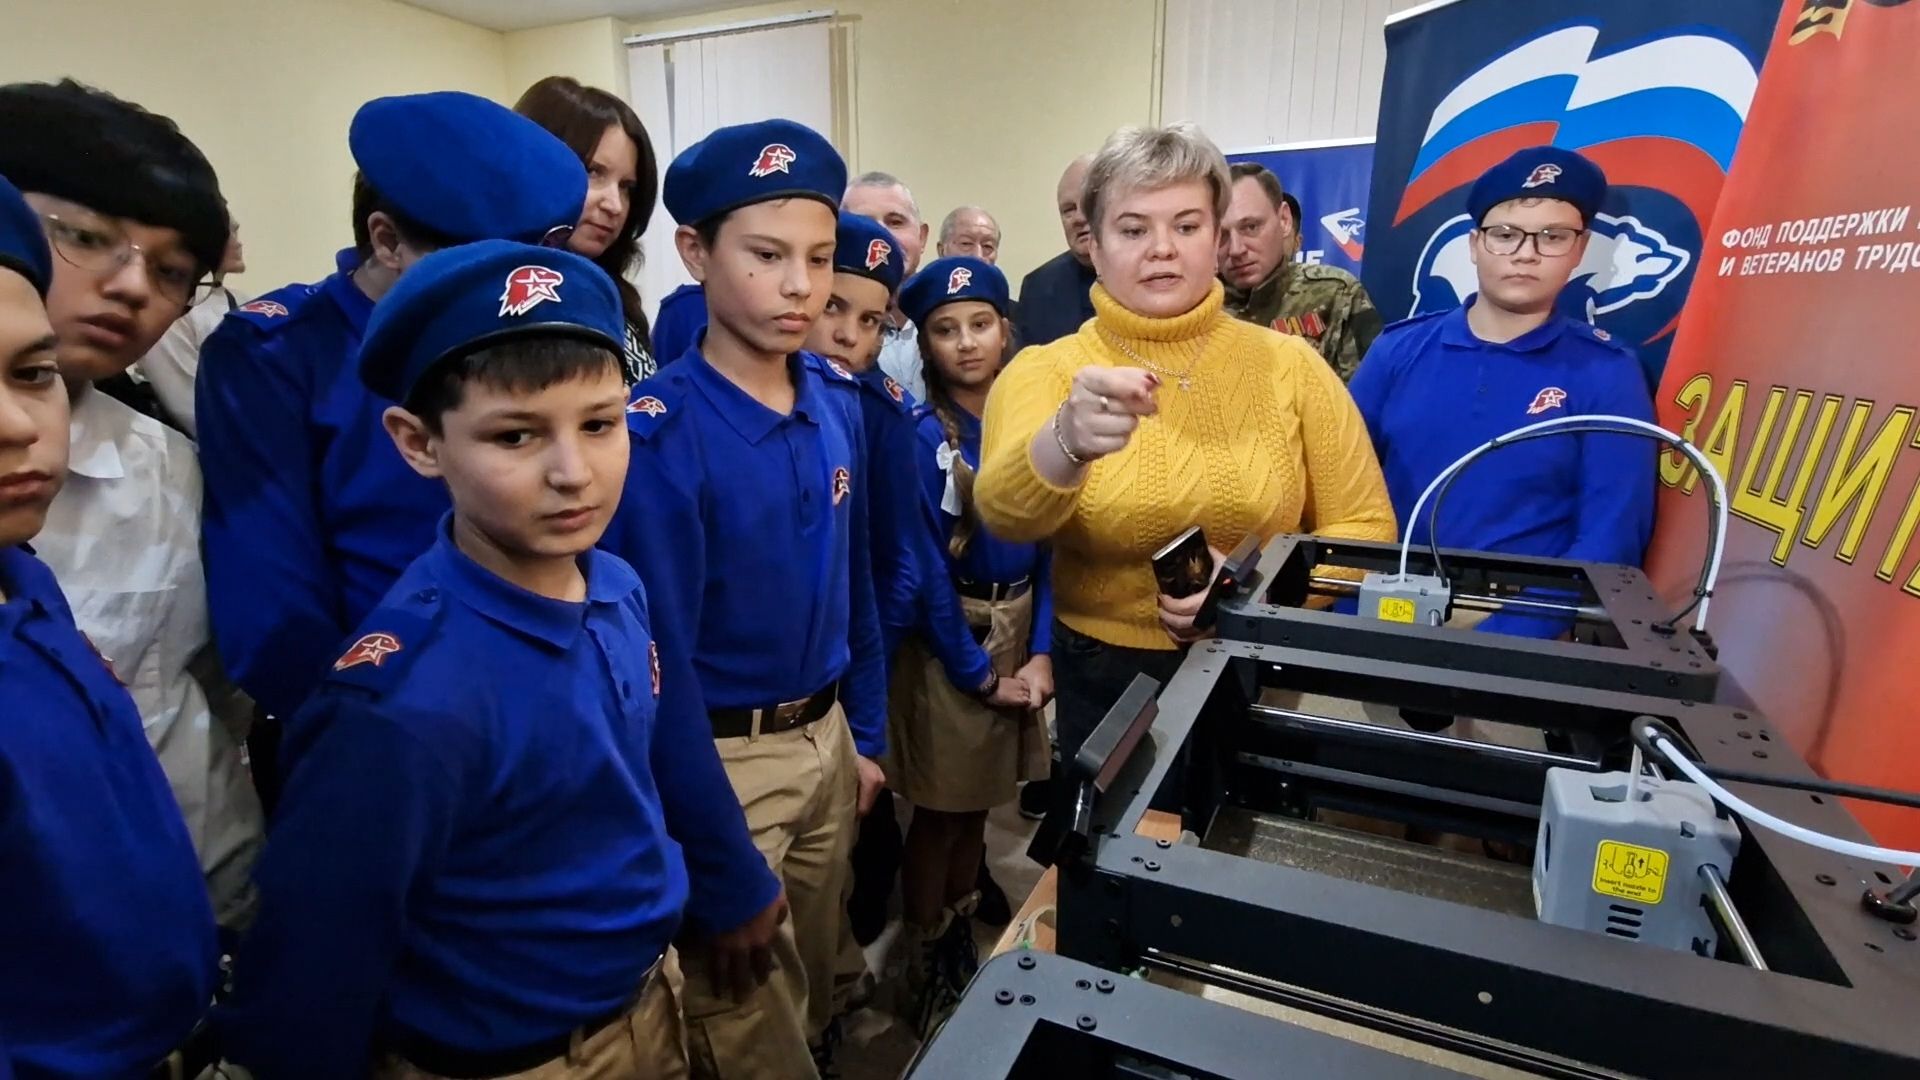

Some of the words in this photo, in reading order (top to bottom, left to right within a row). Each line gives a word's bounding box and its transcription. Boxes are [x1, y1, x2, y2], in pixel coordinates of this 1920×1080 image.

[1721, 224, 1773, 249] ФОНД
[1775, 205, 1911, 245] ПОДДЕРЖКИ
[1718, 256, 1736, 277] И
[1739, 248, 1845, 276] ВЕТЕРАНОВ
[1659, 373, 1920, 599] ЗАЩИТ
